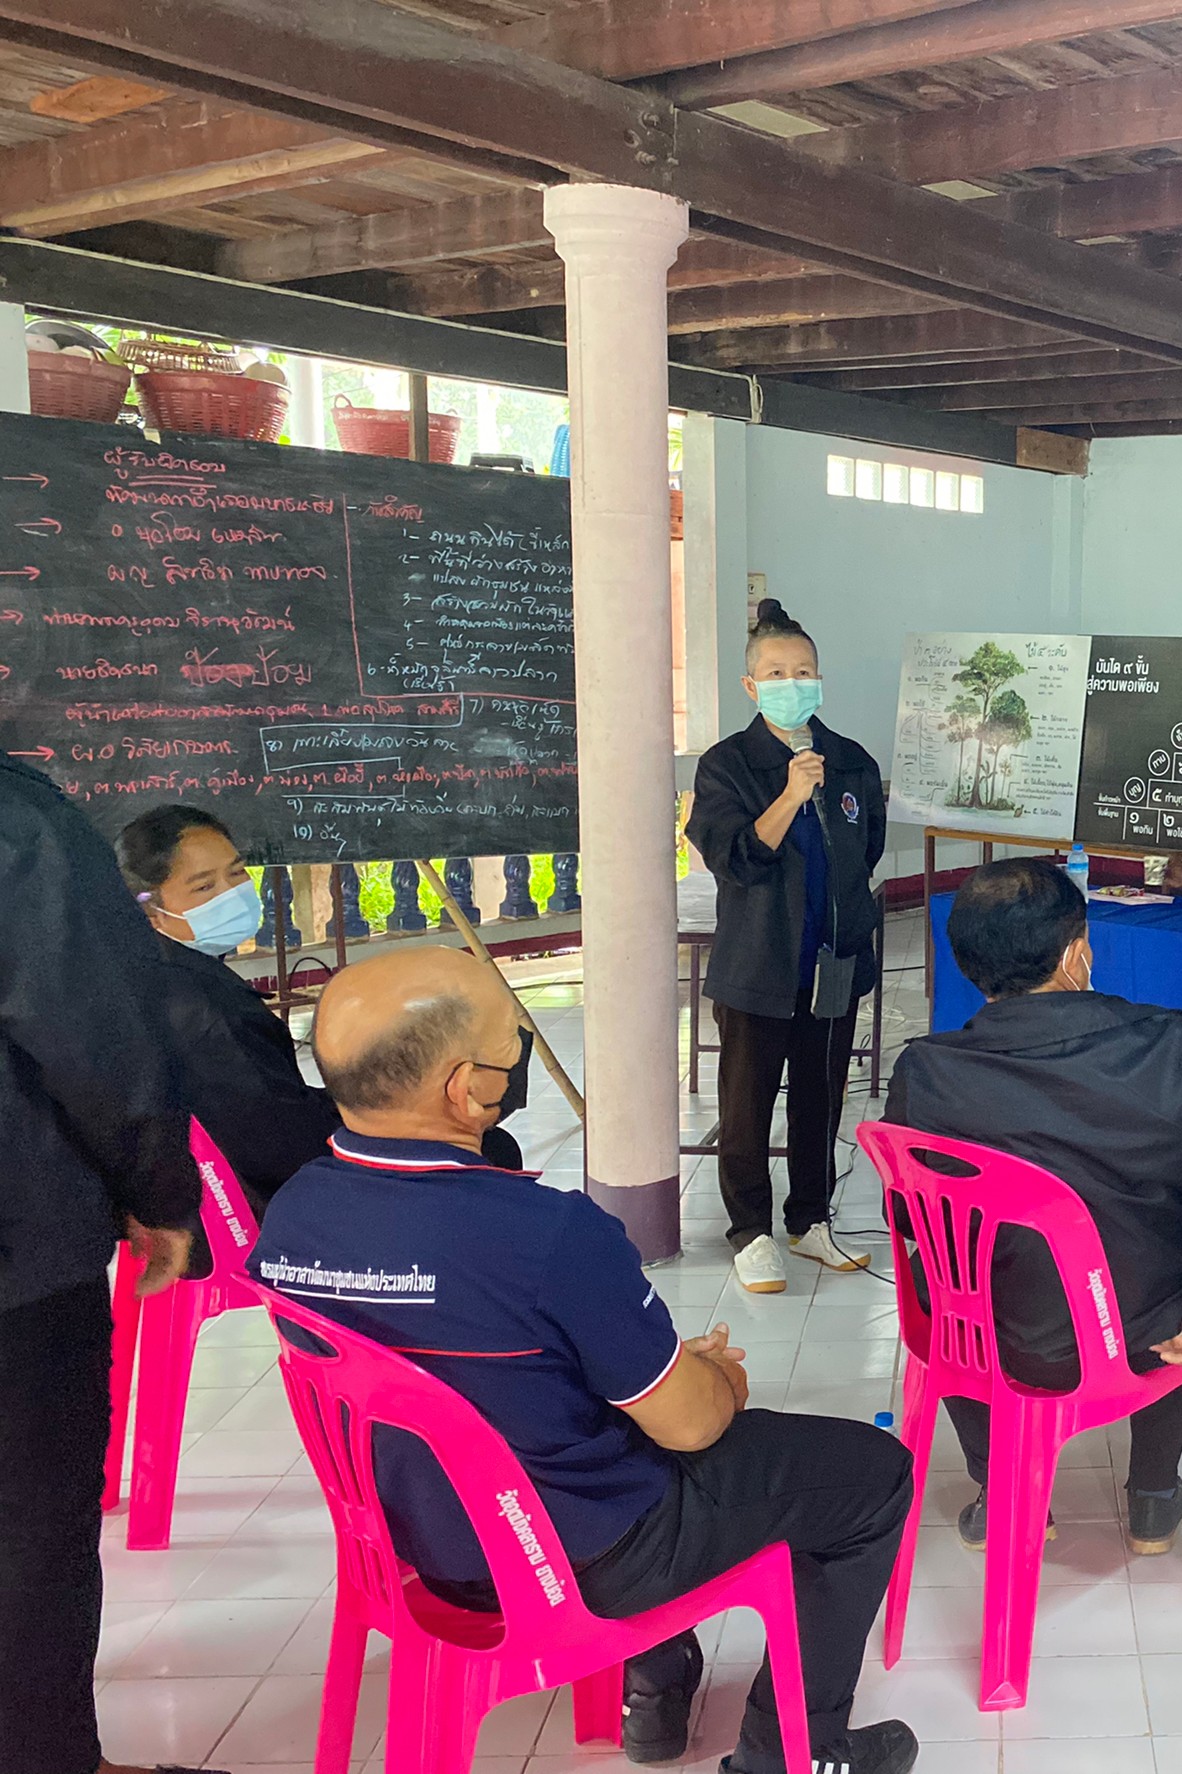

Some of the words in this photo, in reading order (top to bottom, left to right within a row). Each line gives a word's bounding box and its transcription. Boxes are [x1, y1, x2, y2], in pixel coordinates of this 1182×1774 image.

[1096, 658, 1120, 674] บันได
[1123, 663, 1133, 674] ๙
[1136, 655, 1149, 675] ขั้น
[1087, 675, 1160, 696] สู่ความพอเพียง
[1129, 811, 1139, 824] ๑
[1163, 813, 1175, 827] ๒
[1132, 824, 1153, 835] พอกิน
